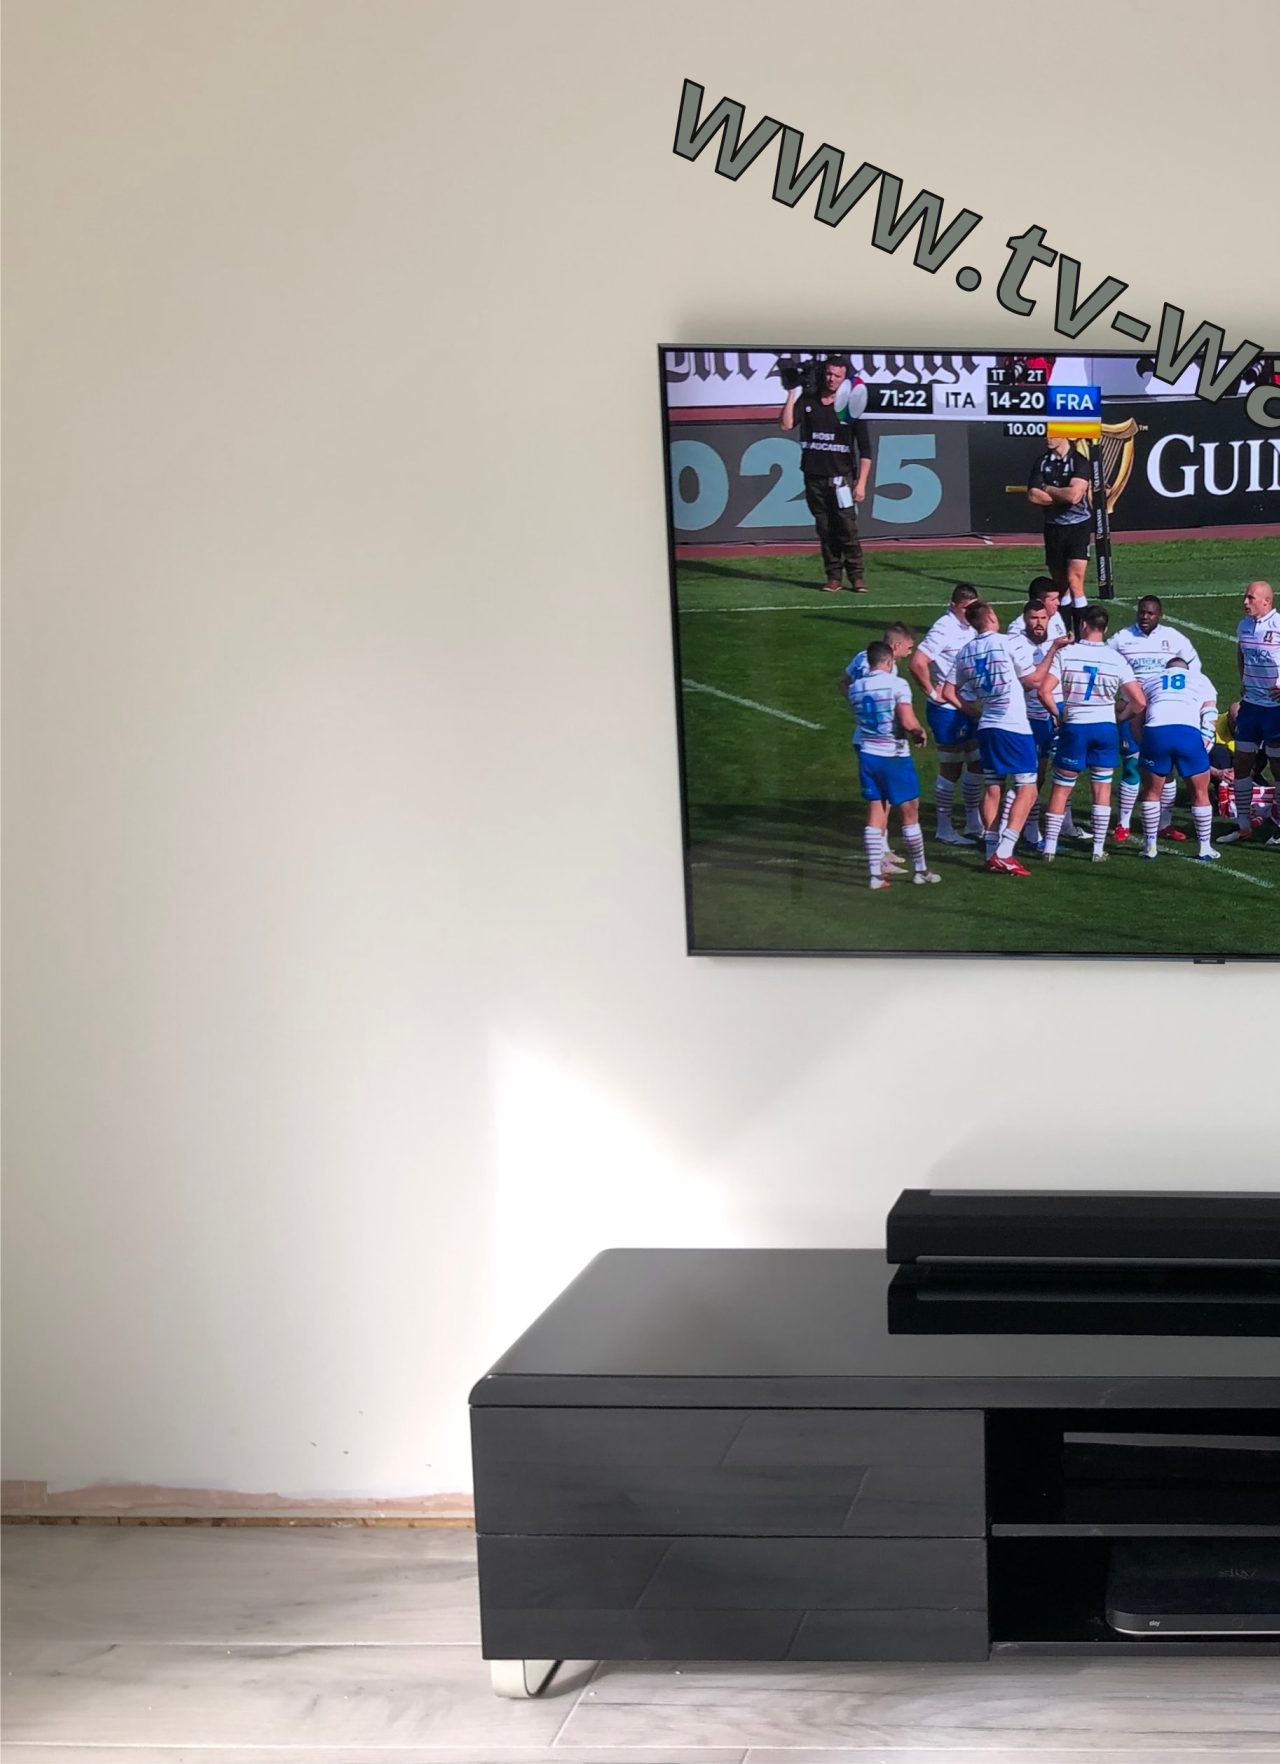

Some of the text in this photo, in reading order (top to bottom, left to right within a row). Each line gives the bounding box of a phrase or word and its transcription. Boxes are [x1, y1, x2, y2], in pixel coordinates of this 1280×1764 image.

[1027, 369, 1043, 382] 2T
[879, 388, 926, 408] 71:22
[944, 391, 976, 409] ITA
[990, 391, 1045, 410] 14-20
[1055, 393, 1094, 411] FRA
[1008, 423, 1046, 436] 10.00
[1082, 665, 1099, 702] 7
[1160, 673, 1186, 690] 18
[1149, 1619, 1160, 1628] sky
